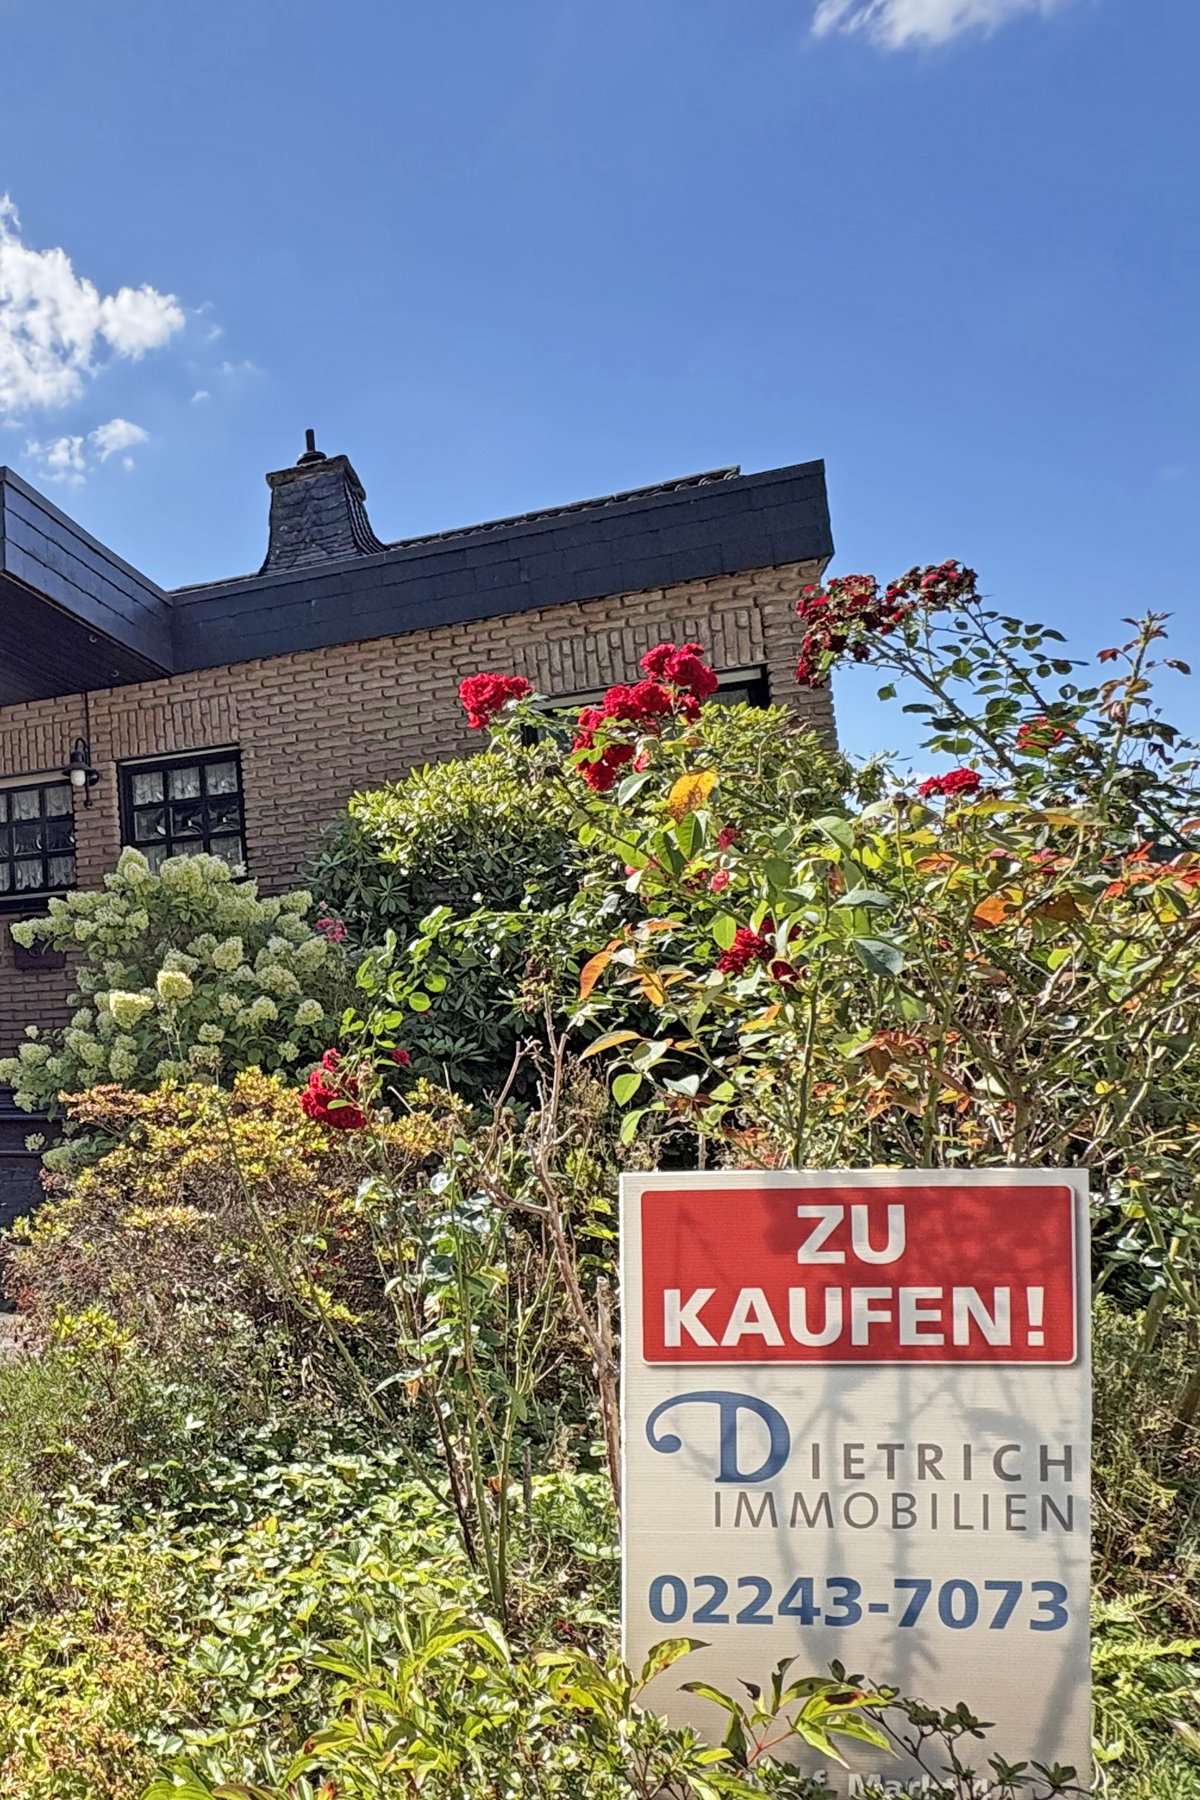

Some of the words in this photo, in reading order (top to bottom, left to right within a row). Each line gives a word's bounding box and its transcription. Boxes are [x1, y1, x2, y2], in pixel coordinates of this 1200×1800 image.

[797, 1204, 906, 1265] ZU
[663, 1286, 1046, 1348] KAUFEN!
[646, 1390, 1073, 1484] DIETRICH
[714, 1491, 1074, 1533] IMMOBILIEN
[648, 1574, 1070, 1632] 02243-7073
